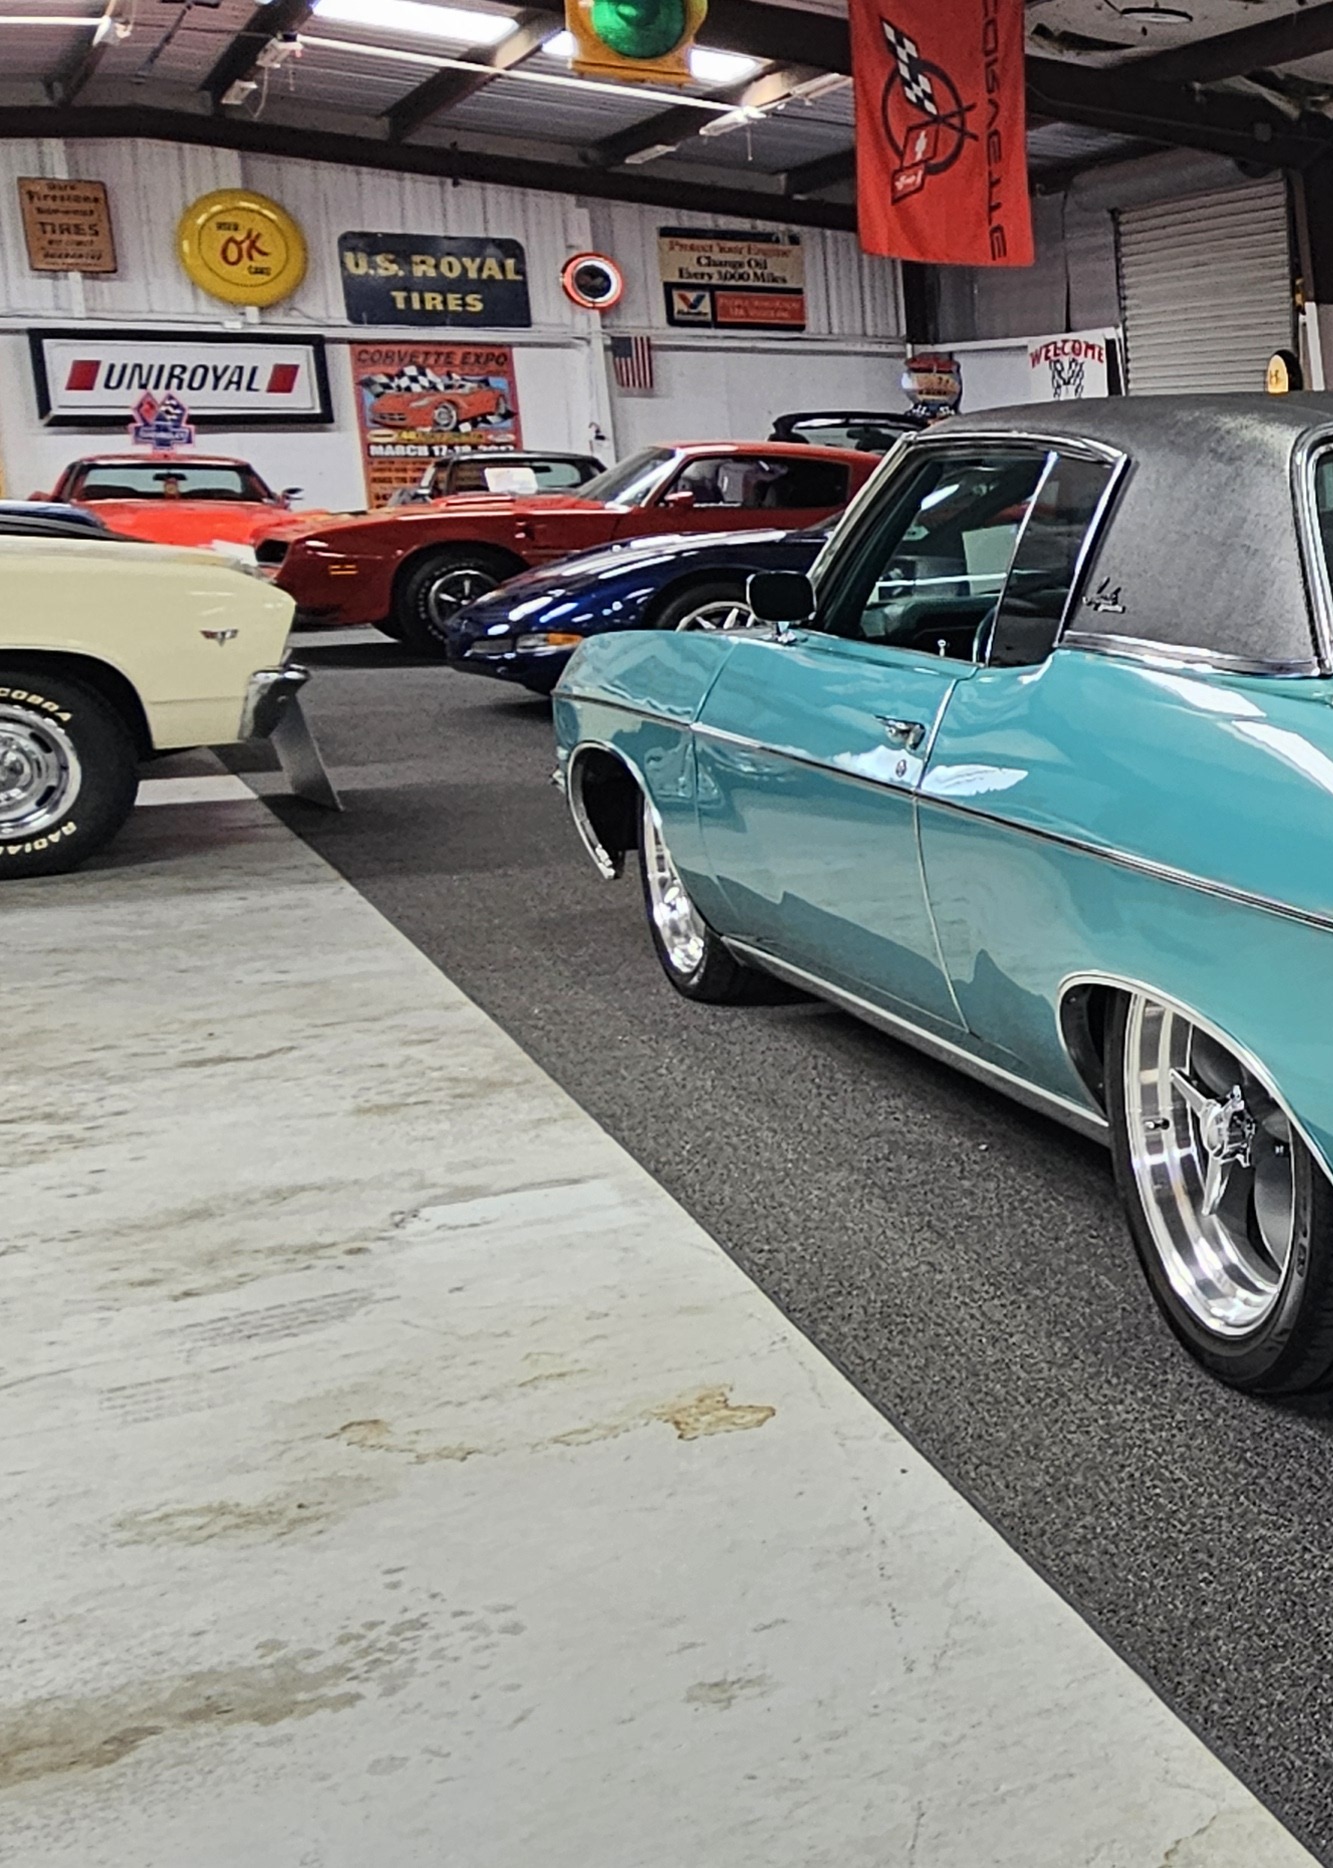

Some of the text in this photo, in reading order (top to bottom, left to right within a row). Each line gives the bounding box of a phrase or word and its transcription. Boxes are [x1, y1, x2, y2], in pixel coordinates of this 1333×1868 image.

[38, 222, 99, 236] TIRES
[221, 227, 270, 266] OK
[346, 251, 523, 281] U.S. ROYAL
[696, 256, 768, 270] Change Oil
[678, 267, 713, 281] Every
[753, 272, 787, 283] Miles
[391, 291, 484, 313] TIRES
[357, 350, 508, 367] CORVETTE EXPO
[1029, 339, 1106, 369] WELCOME
[103, 362, 261, 392] UNIROYAL
[369, 445, 429, 456] MARCH
